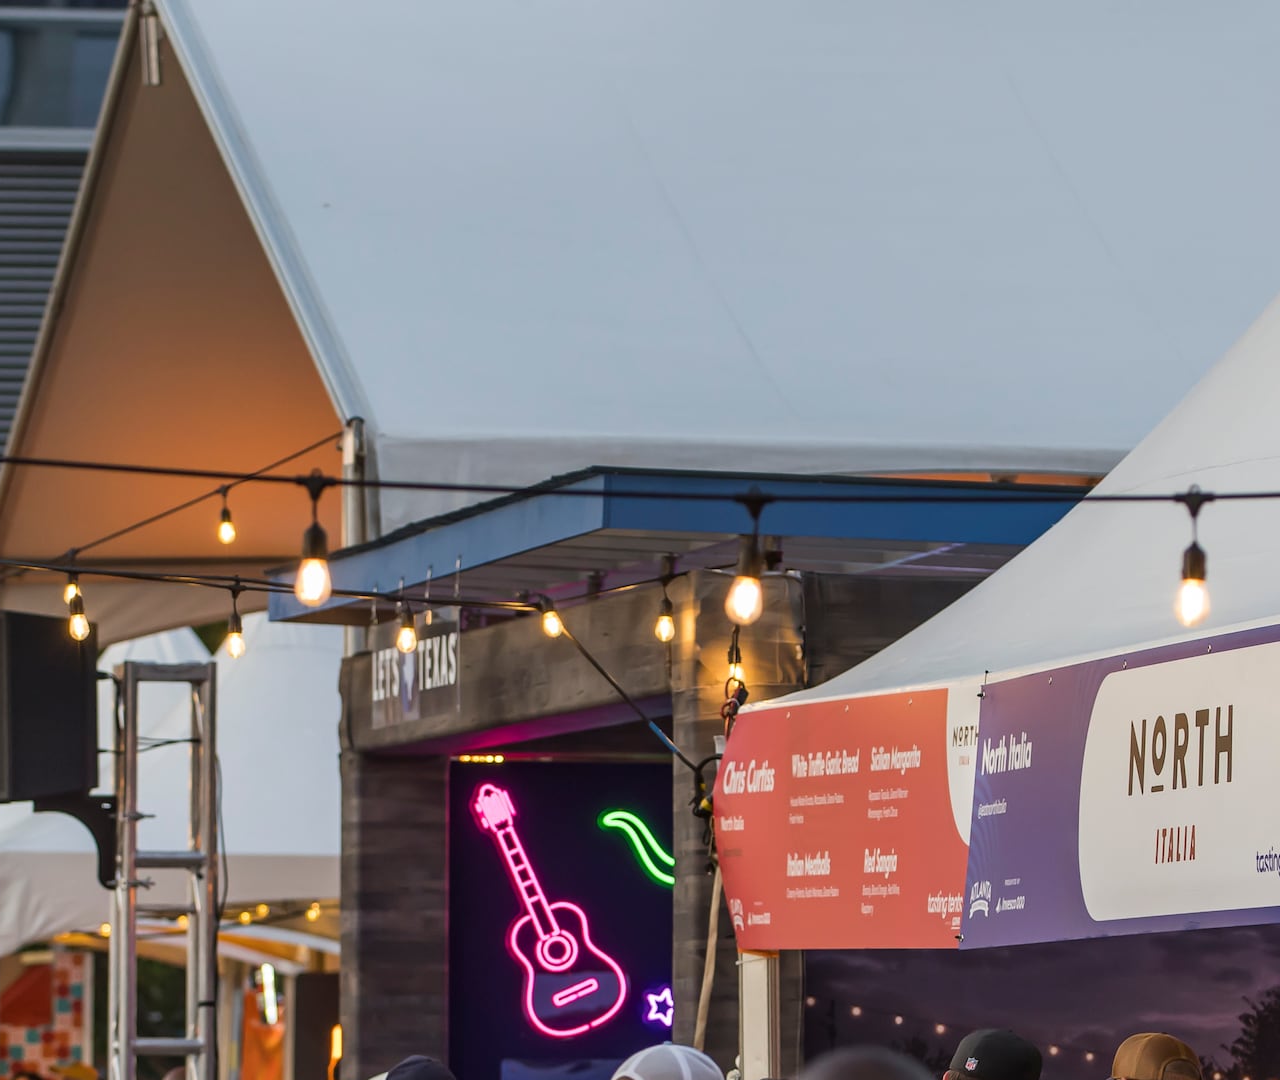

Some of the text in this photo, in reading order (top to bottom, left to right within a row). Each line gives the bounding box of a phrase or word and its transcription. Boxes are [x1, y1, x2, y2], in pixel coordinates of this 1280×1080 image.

[372, 632, 458, 702] LETS TEXAS
[952, 725, 979, 747] NORTH
[1128, 704, 1233, 796] NORTH
[792, 753, 807, 778] White
[842, 748, 860, 774] Bread
[891, 744, 921, 775] Margarita
[981, 732, 1033, 775] North Italia
[723, 759, 776, 794] Chris Curtiss
[1155, 824, 1196, 864] ITALIA
[786, 851, 831, 877] Italian Meatballs
[864, 848, 898, 879] Red Sangria
